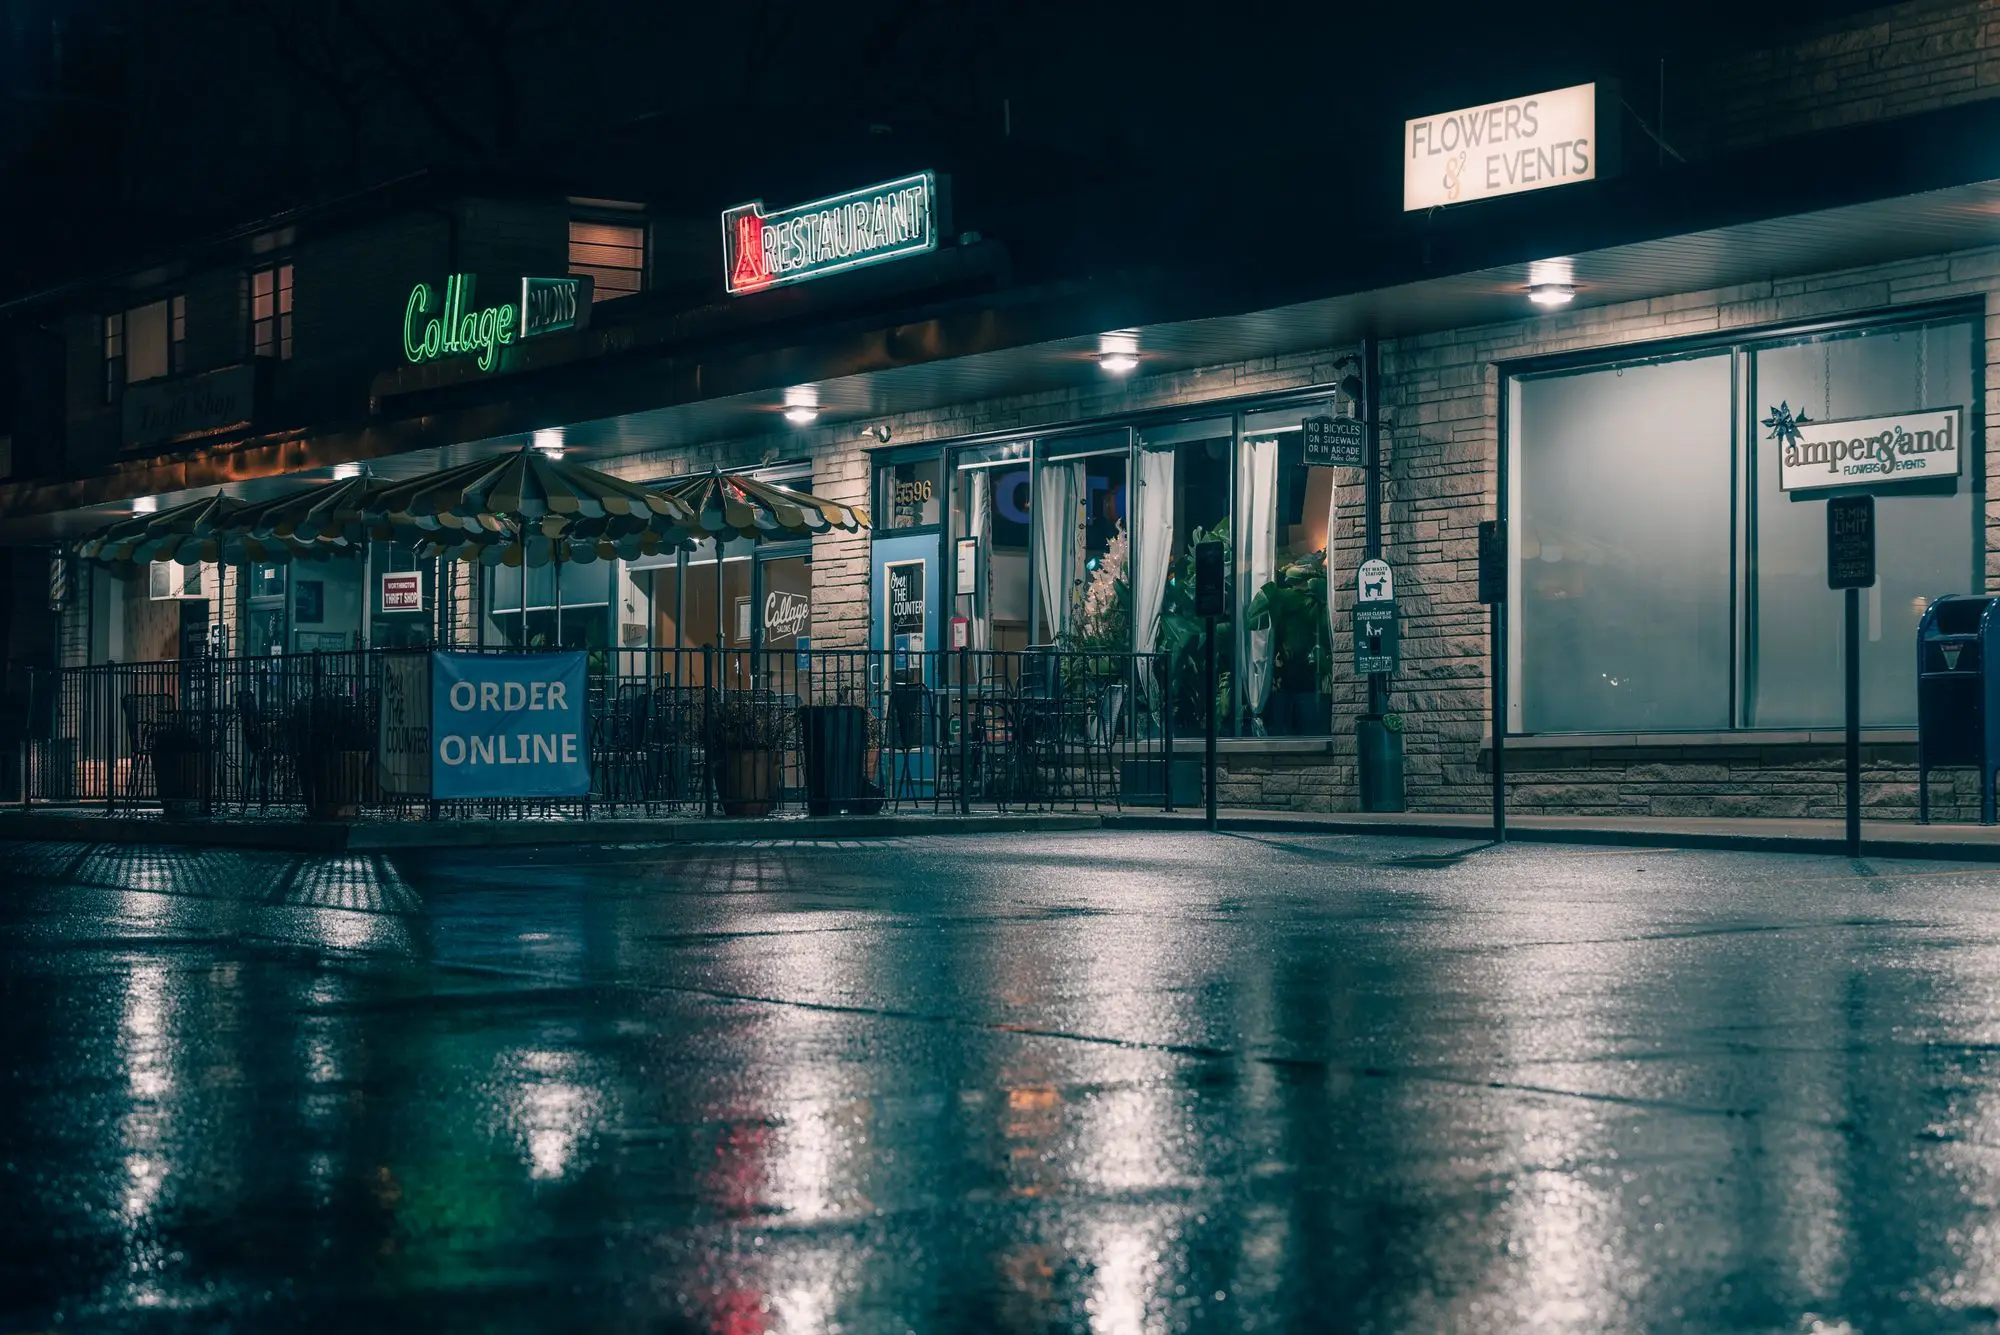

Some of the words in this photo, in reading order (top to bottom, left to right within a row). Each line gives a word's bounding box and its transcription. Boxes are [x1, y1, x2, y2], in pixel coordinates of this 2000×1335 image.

[1412, 100, 1539, 159] FLOWERS
[1442, 150, 1467, 200] &
[1486, 138, 1589, 190] EVENTS
[760, 186, 922, 275] RESTAURANT
[403, 273, 513, 371] Collage
[1308, 422, 1320, 433] NO
[1323, 423, 1361, 436] BICYCLES
[1308, 434, 1320, 443] ON
[1323, 435, 1361, 446] SIDEWALK
[1308, 444, 1319, 453] OR
[1321, 445, 1329, 454] IN
[1331, 446, 1360, 455] ARCADE
[1843, 463, 1882, 476] FLOWERS
[1895, 458, 1927, 471] EVENTS
[896, 480, 932, 503] 5596
[1847, 505, 1868, 520] MIN
[1834, 519, 1868, 535] LIMIT
[890, 571, 907, 590] Over
[385, 592, 403, 605] THRIFT
[403, 591, 418, 604] SHOP
[893, 588, 907, 602] THE
[764, 592, 810, 635] Collage
[893, 600, 924, 617] COUNTER
[776, 624, 792, 633] SALONS
[449, 681, 569, 712] ORDER
[386, 726, 429, 754] COUNTER
[439, 733, 578, 766] ONLINE
